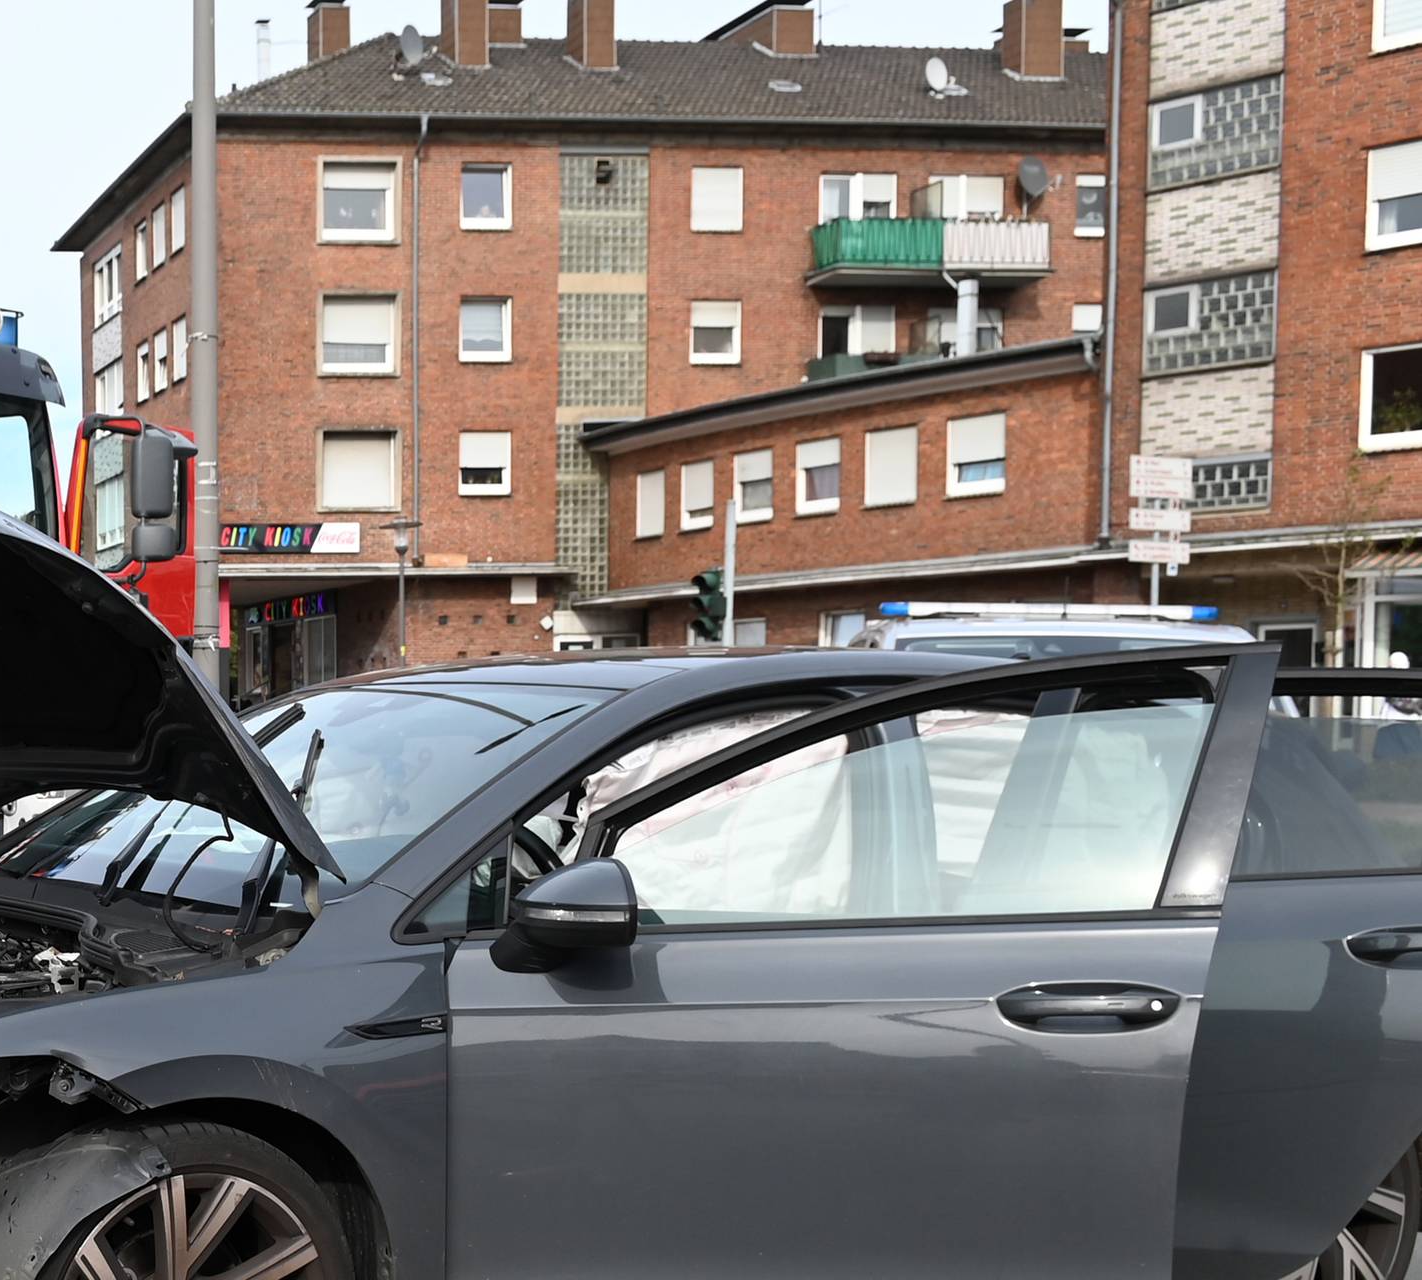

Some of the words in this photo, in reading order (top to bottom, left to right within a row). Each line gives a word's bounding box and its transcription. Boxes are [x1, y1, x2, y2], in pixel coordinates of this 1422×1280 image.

[221, 526, 257, 547] CITY
[263, 526, 315, 547] KIOSK
[264, 599, 287, 622] CITY
[291, 592, 324, 618] KIOSK
